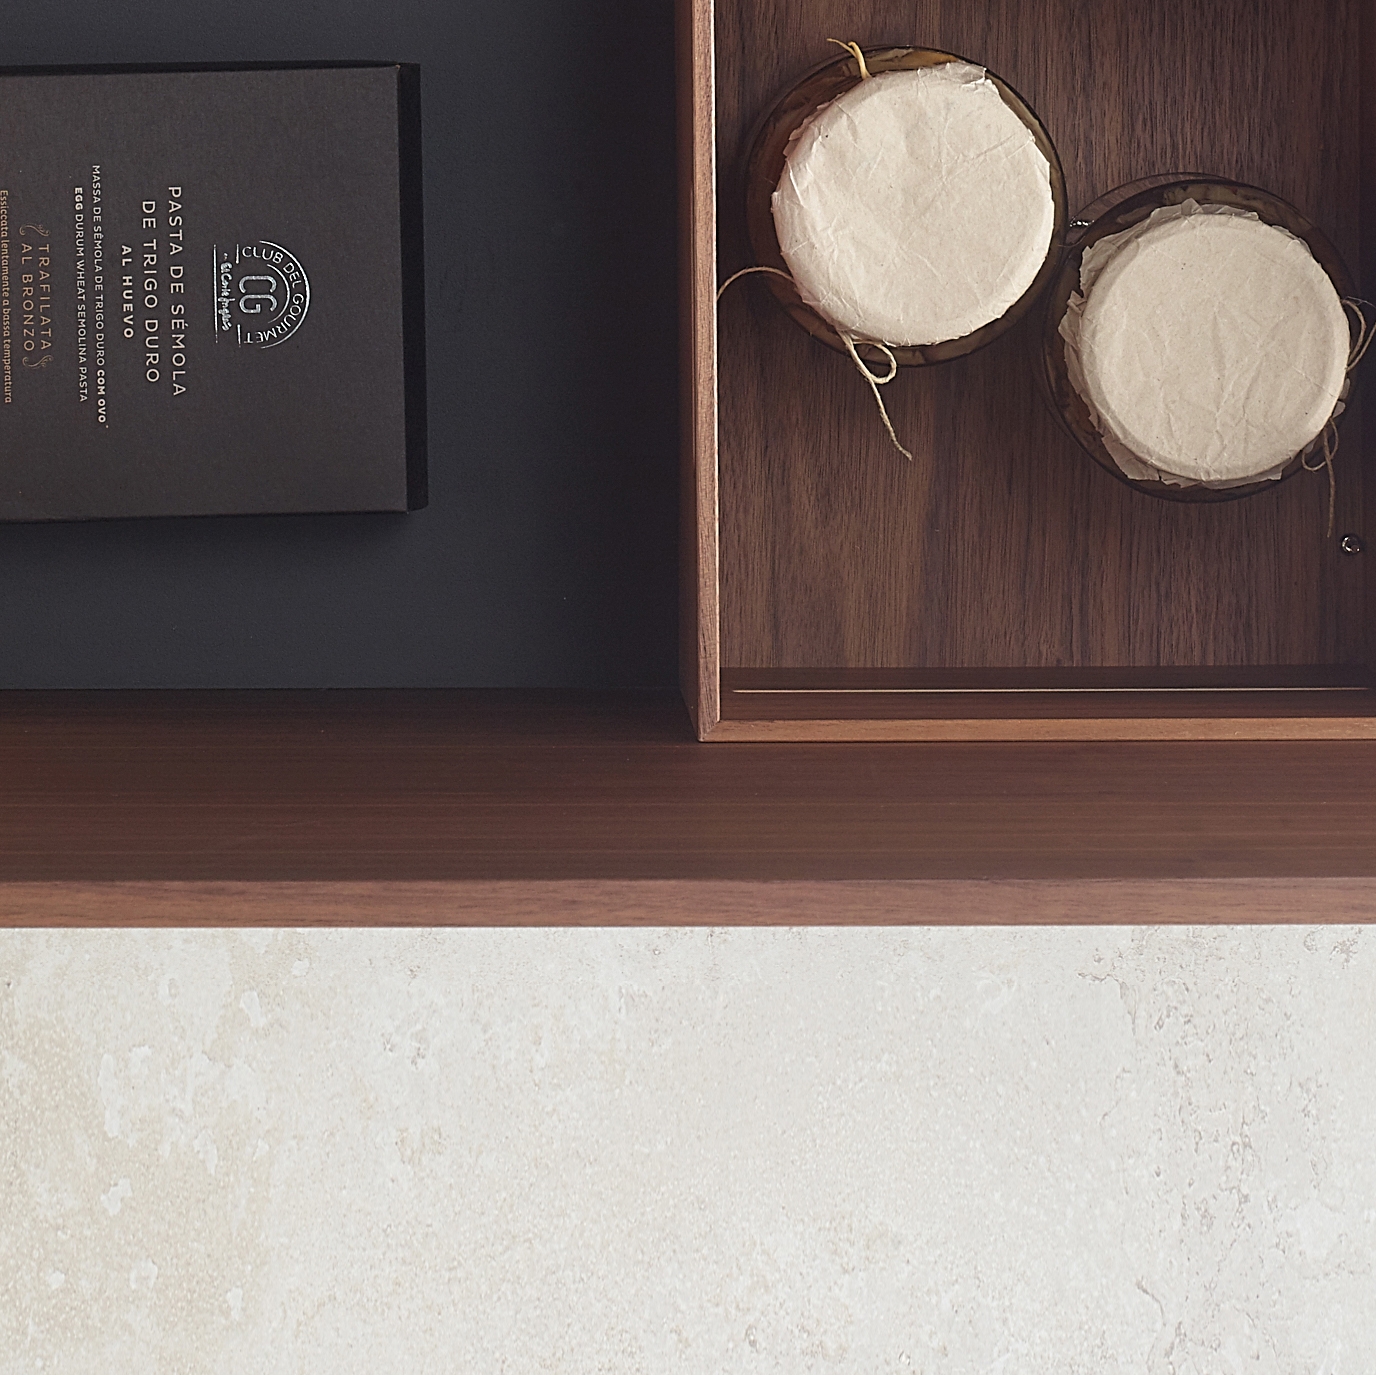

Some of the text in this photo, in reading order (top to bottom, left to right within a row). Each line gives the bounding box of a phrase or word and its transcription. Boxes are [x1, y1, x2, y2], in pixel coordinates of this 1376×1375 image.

[0, 190, 8, 237] Essiccata
[0, 240, 10, 297] lentamente
[21, 243, 35, 352] AL BRONZO
[38, 244, 52, 350] TRAFILATA
[74, 187, 88, 402] EGG DURUM WHEAT SEMOLINA PASTA
[92, 165, 107, 423] MASSA DE SÊMOLA DE TRIGO DURO COM OVO
[121, 245, 134, 339] AL HUEVO
[142, 201, 160, 382] DE TRIGO DURO
[168, 186, 188, 396] PASTA DE SÉMOLA
[238, 275, 278, 314] CG
[241, 246, 304, 344] CLUB DEL GOURMET
[0, 339, 13, 403] temperatura
[2, 308, 12, 337] bassa
